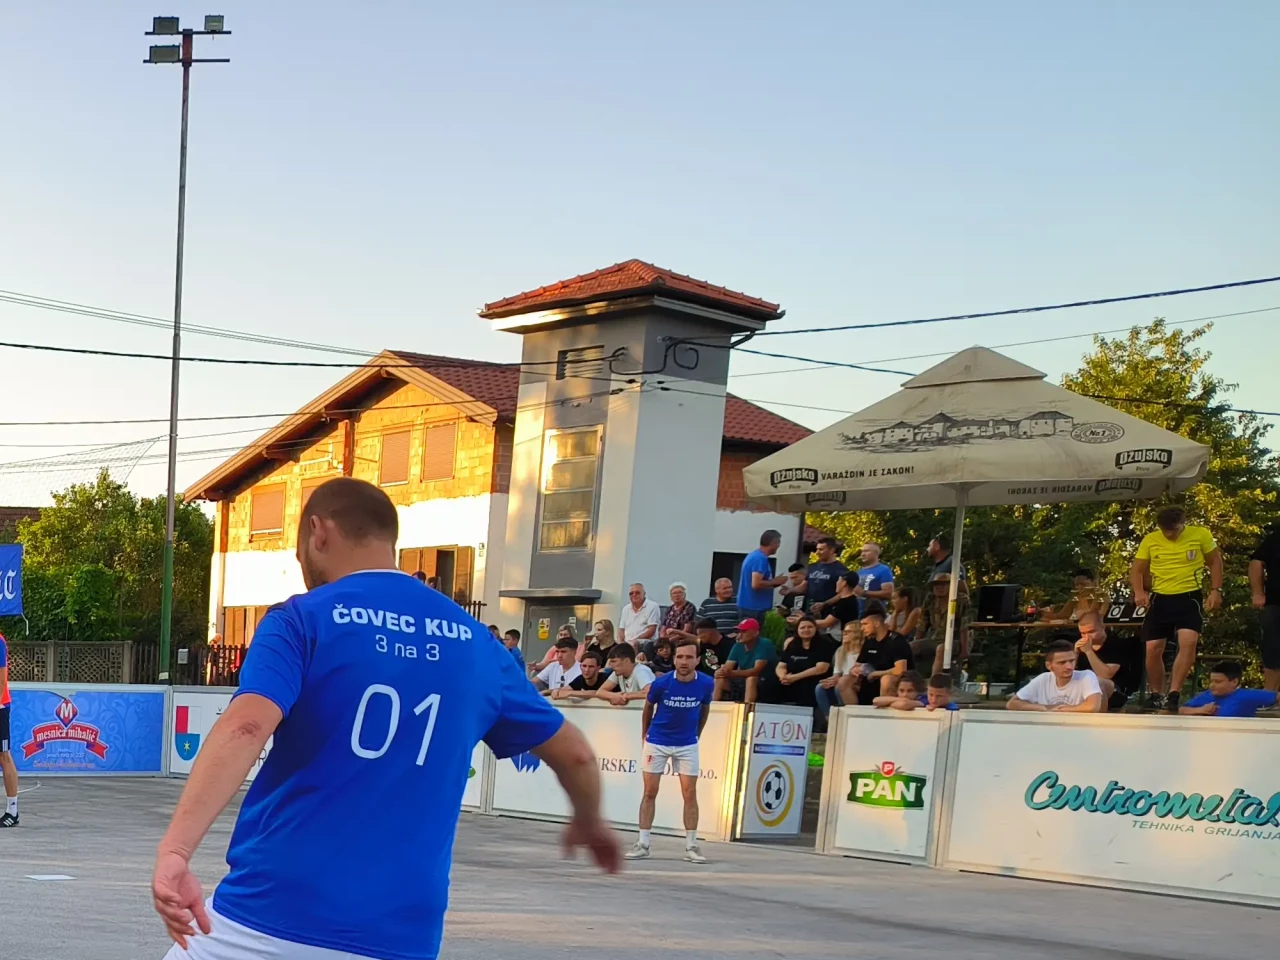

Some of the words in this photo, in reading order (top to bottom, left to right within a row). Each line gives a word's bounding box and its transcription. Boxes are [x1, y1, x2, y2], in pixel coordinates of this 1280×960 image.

[821, 470, 865, 480] VARAŽDIN
[868, 469, 878, 477] JE
[881, 466, 915, 476] ZAKON!
[332, 603, 416, 634] ČOVEC
[424, 617, 473, 641] KUP
[375, 634, 388, 653] 3
[394, 643, 418, 659] na
[425, 643, 440, 661] 3
[60, 703, 73, 720] M
[350, 683, 441, 767] 01
[855, 778, 917, 802] PAN
[1131, 820, 1195, 833] TEHNIKA
[1204, 826, 1280, 840] GRIJANJA
